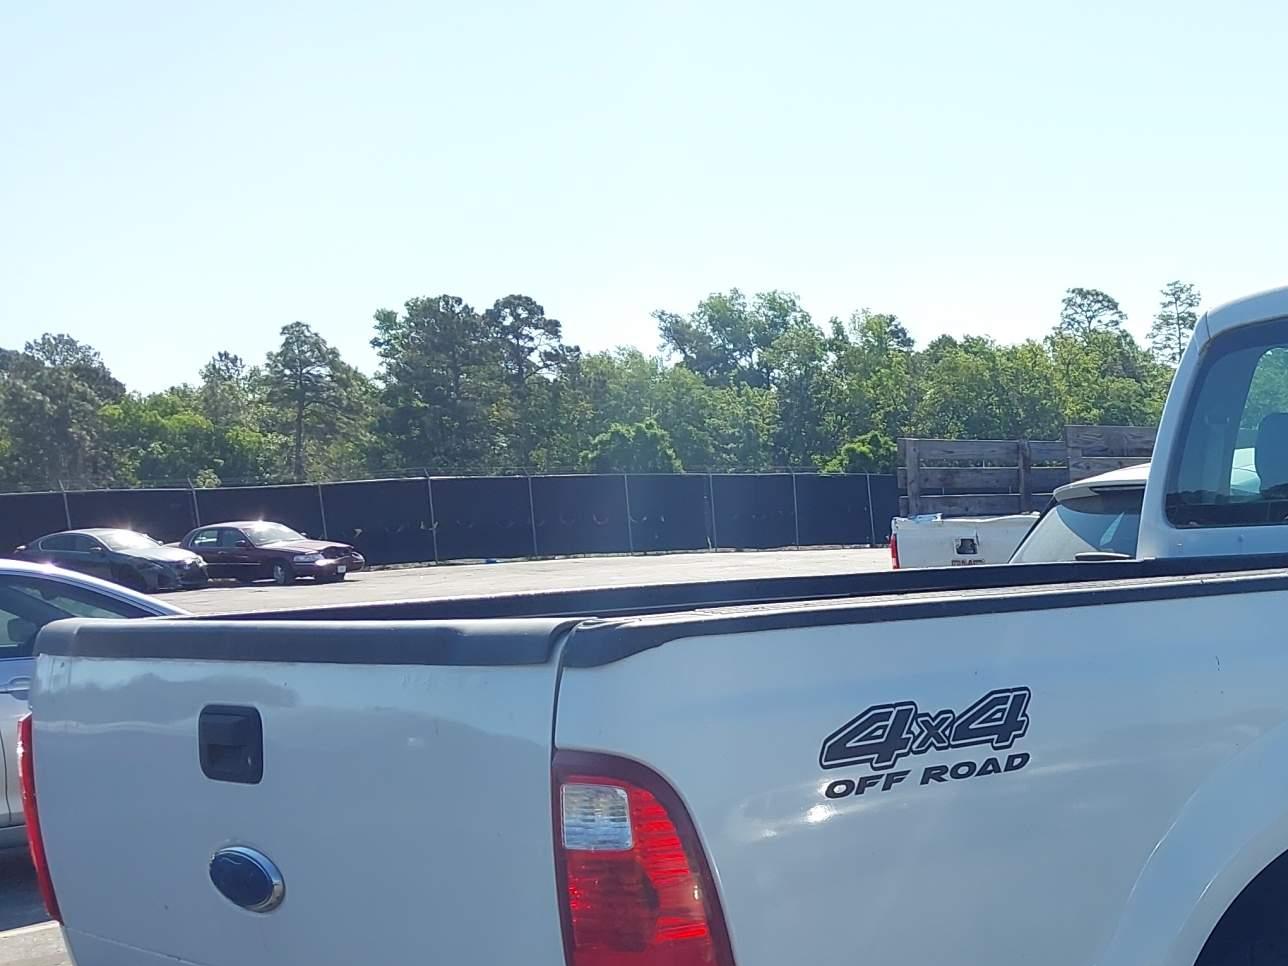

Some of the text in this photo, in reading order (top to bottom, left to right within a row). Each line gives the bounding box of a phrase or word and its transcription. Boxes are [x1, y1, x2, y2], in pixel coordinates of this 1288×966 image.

[819, 686, 1031, 772] 4x4
[825, 752, 1030, 800] OFF ROAD
